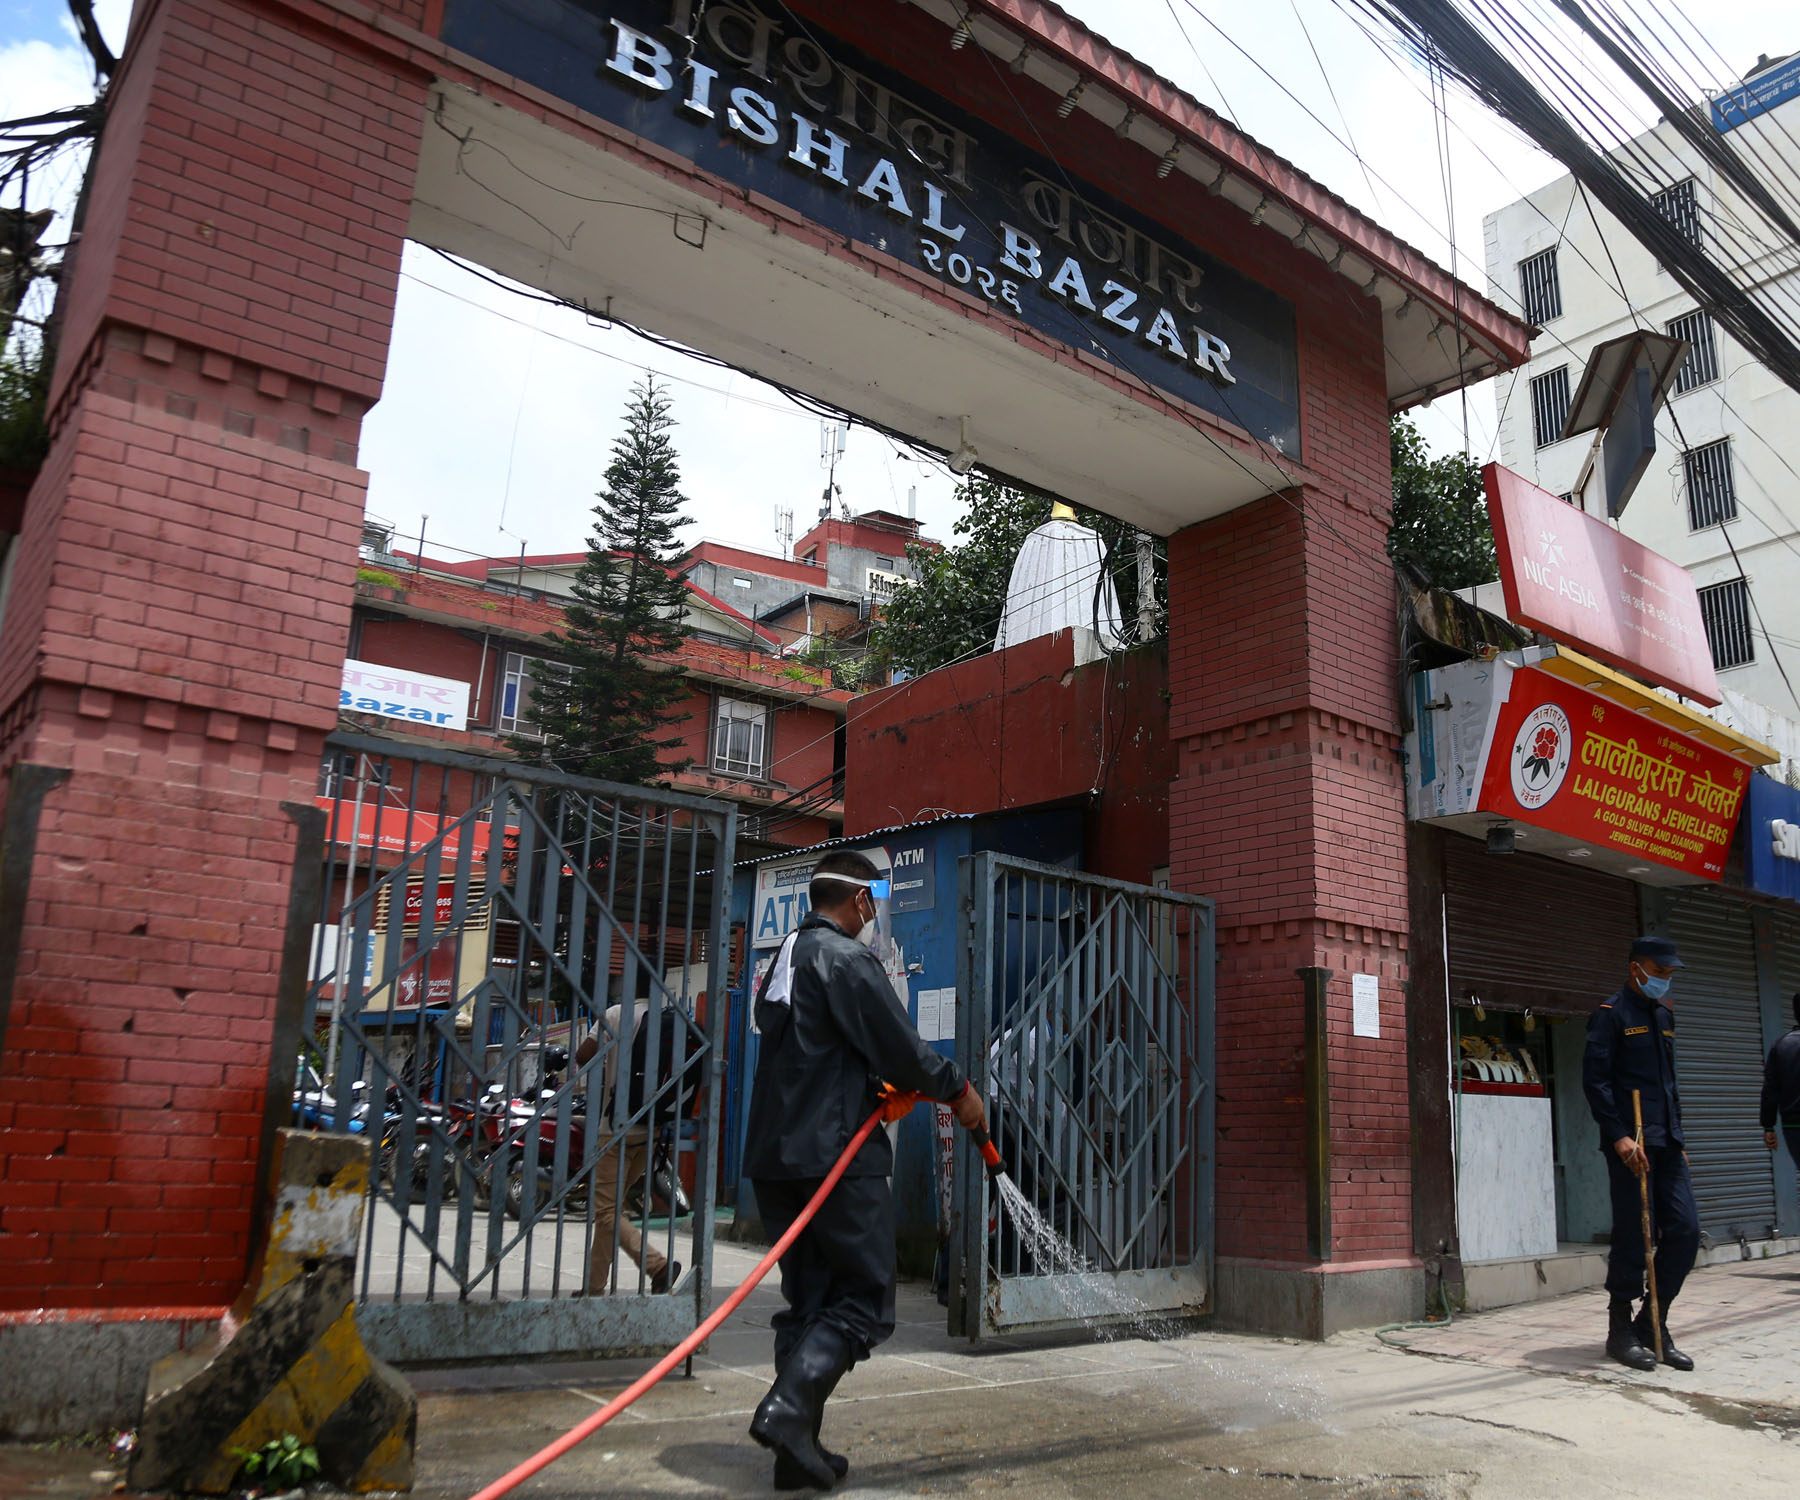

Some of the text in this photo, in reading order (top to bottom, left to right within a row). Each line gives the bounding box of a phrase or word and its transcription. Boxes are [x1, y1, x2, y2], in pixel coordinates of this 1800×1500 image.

[603, 17, 1236, 384] BISHAL BAZAR
[1522, 556, 1600, 613] NIC ASIA
[1572, 774, 1729, 846] LALIGURANS JEWELLERS
[1594, 808, 1704, 854] A GOLD SILVER AND DIAMOND
[893, 847, 925, 868] ATM
[1609, 830, 1686, 862] JEWELLERY SHOWROOM
